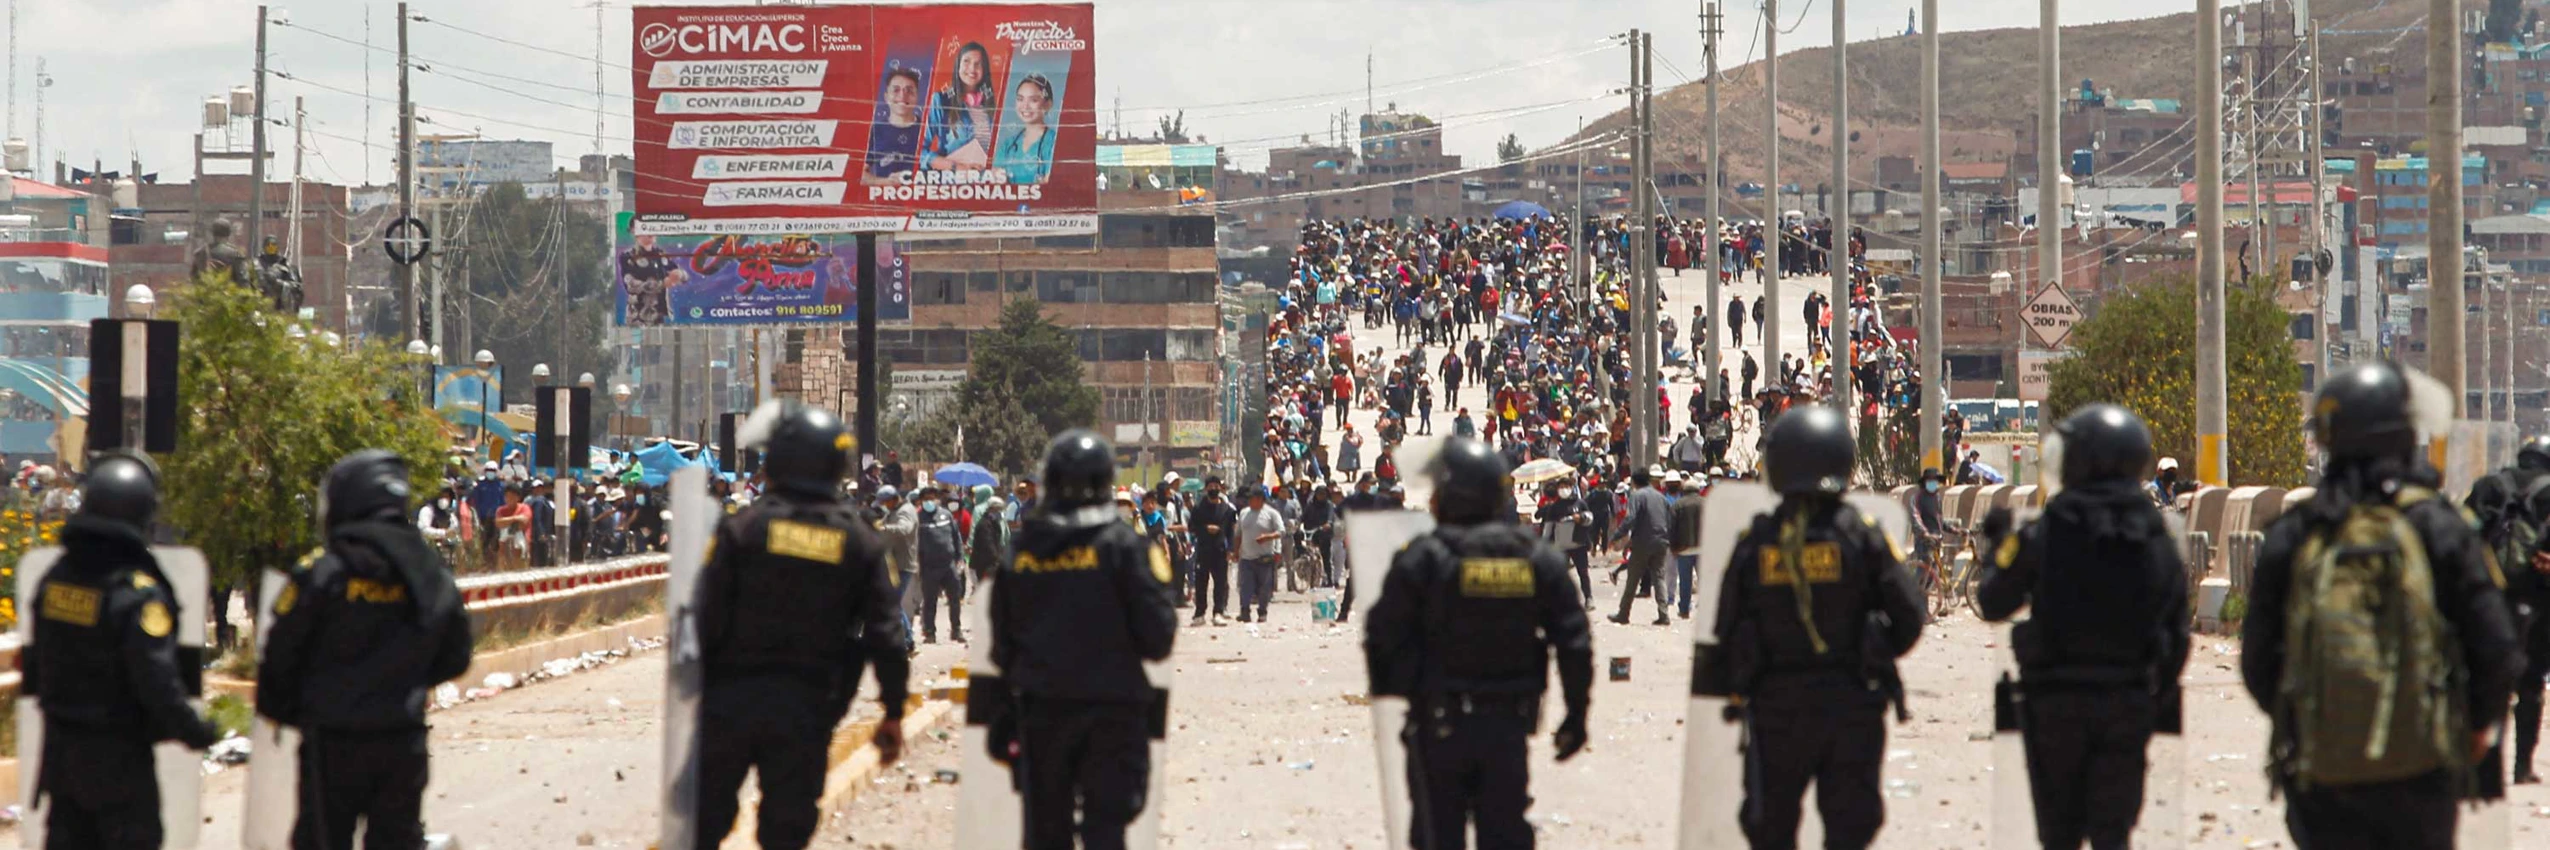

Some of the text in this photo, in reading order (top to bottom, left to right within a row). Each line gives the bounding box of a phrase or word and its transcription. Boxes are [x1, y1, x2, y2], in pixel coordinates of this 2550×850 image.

[821, 25, 843, 34] Crea
[821, 34, 849, 42] Crece
[995, 19, 1076, 55] Proyectos
[828, 43, 862, 51] Avanza
[1034, 42, 1083, 50] CONTIGO
[679, 75, 790, 87] DE EMPRESAS
[686, 96, 805, 108] CONTABILIDAD
[700, 122, 816, 136] COMPUTACIÓN
[700, 135, 821, 147] E INFORMÁTICA
[726, 159, 834, 172] ENFERMERÍA
[900, 170, 1007, 185] CARRERAS
[735, 187, 823, 199] FARMACIA
[869, 185, 1042, 200] PROFESIONALES
[710, 304, 843, 318] contactos: 916 809591
[2031, 303, 2073, 315] OBRAS
[2033, 316, 2070, 327] 200 m
